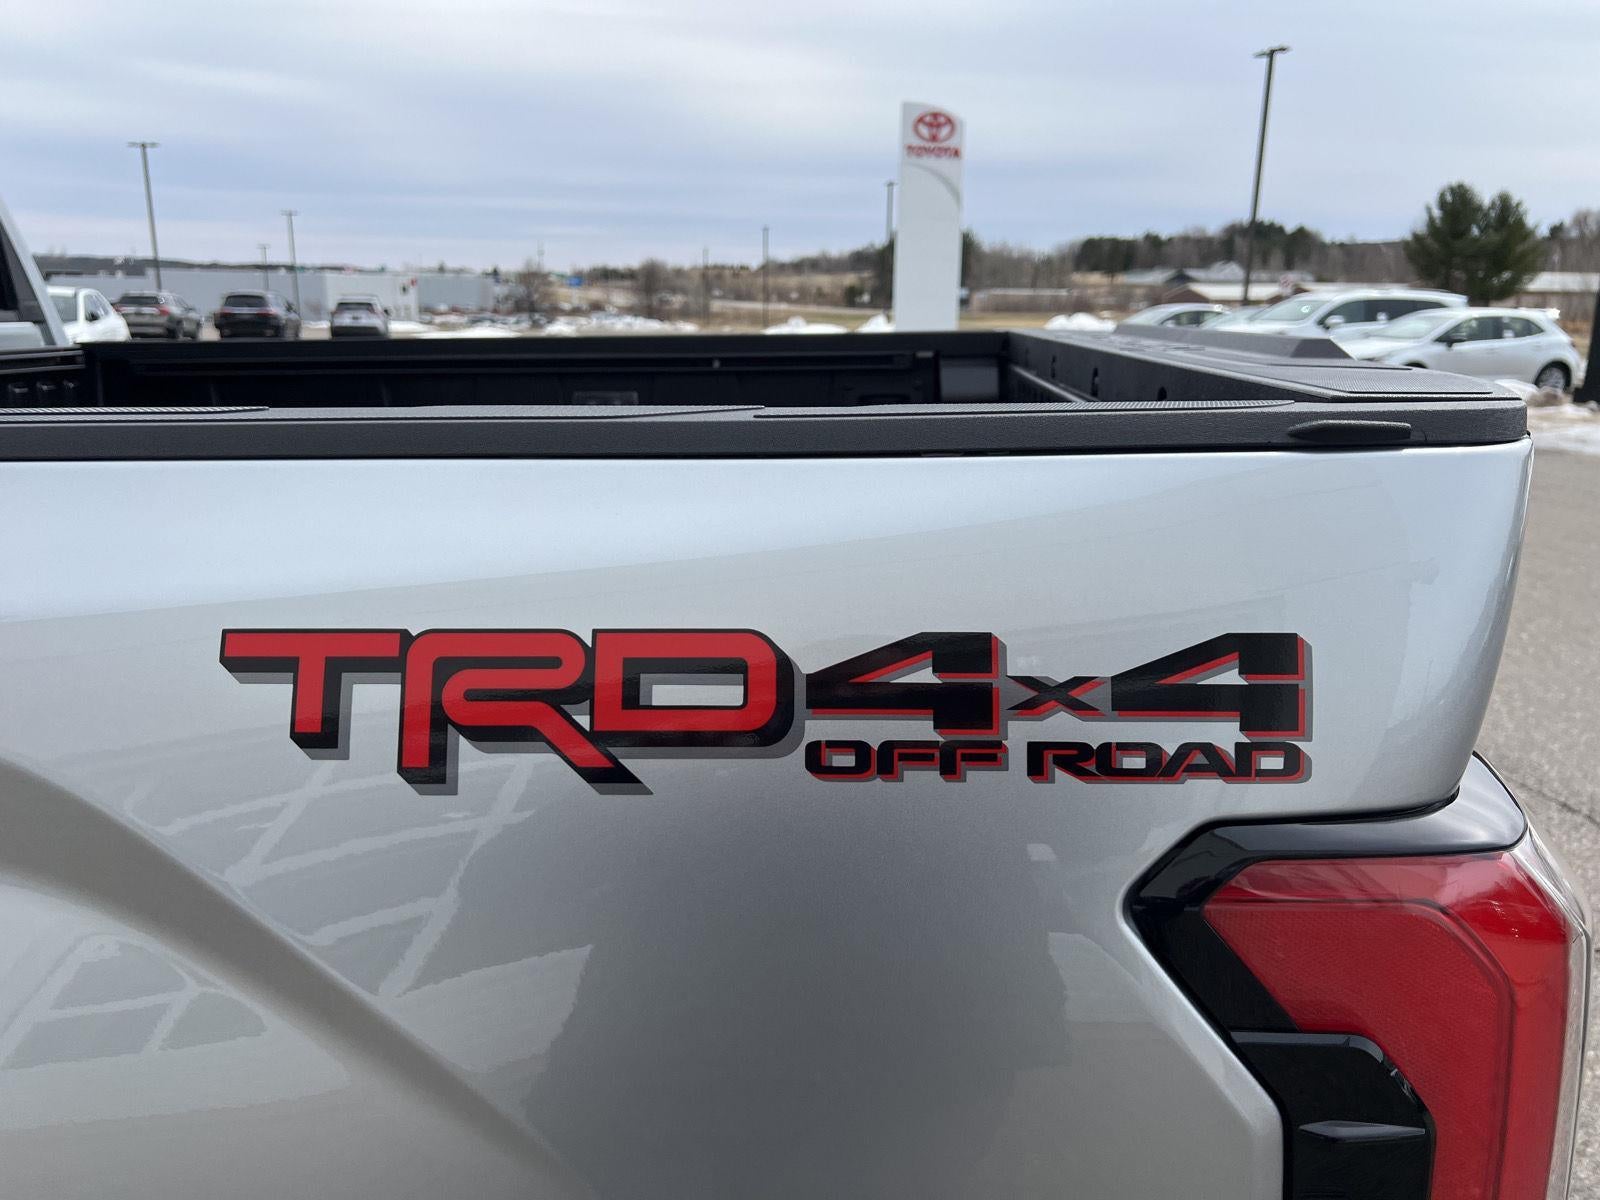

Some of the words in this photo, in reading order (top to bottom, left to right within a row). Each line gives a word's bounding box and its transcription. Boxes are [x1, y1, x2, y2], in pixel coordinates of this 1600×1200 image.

[906, 144, 961, 158] TOYOTA
[220, 628, 802, 795] TRD
[805, 739, 1009, 782] OFF
[1026, 740, 1313, 784] ROAD
